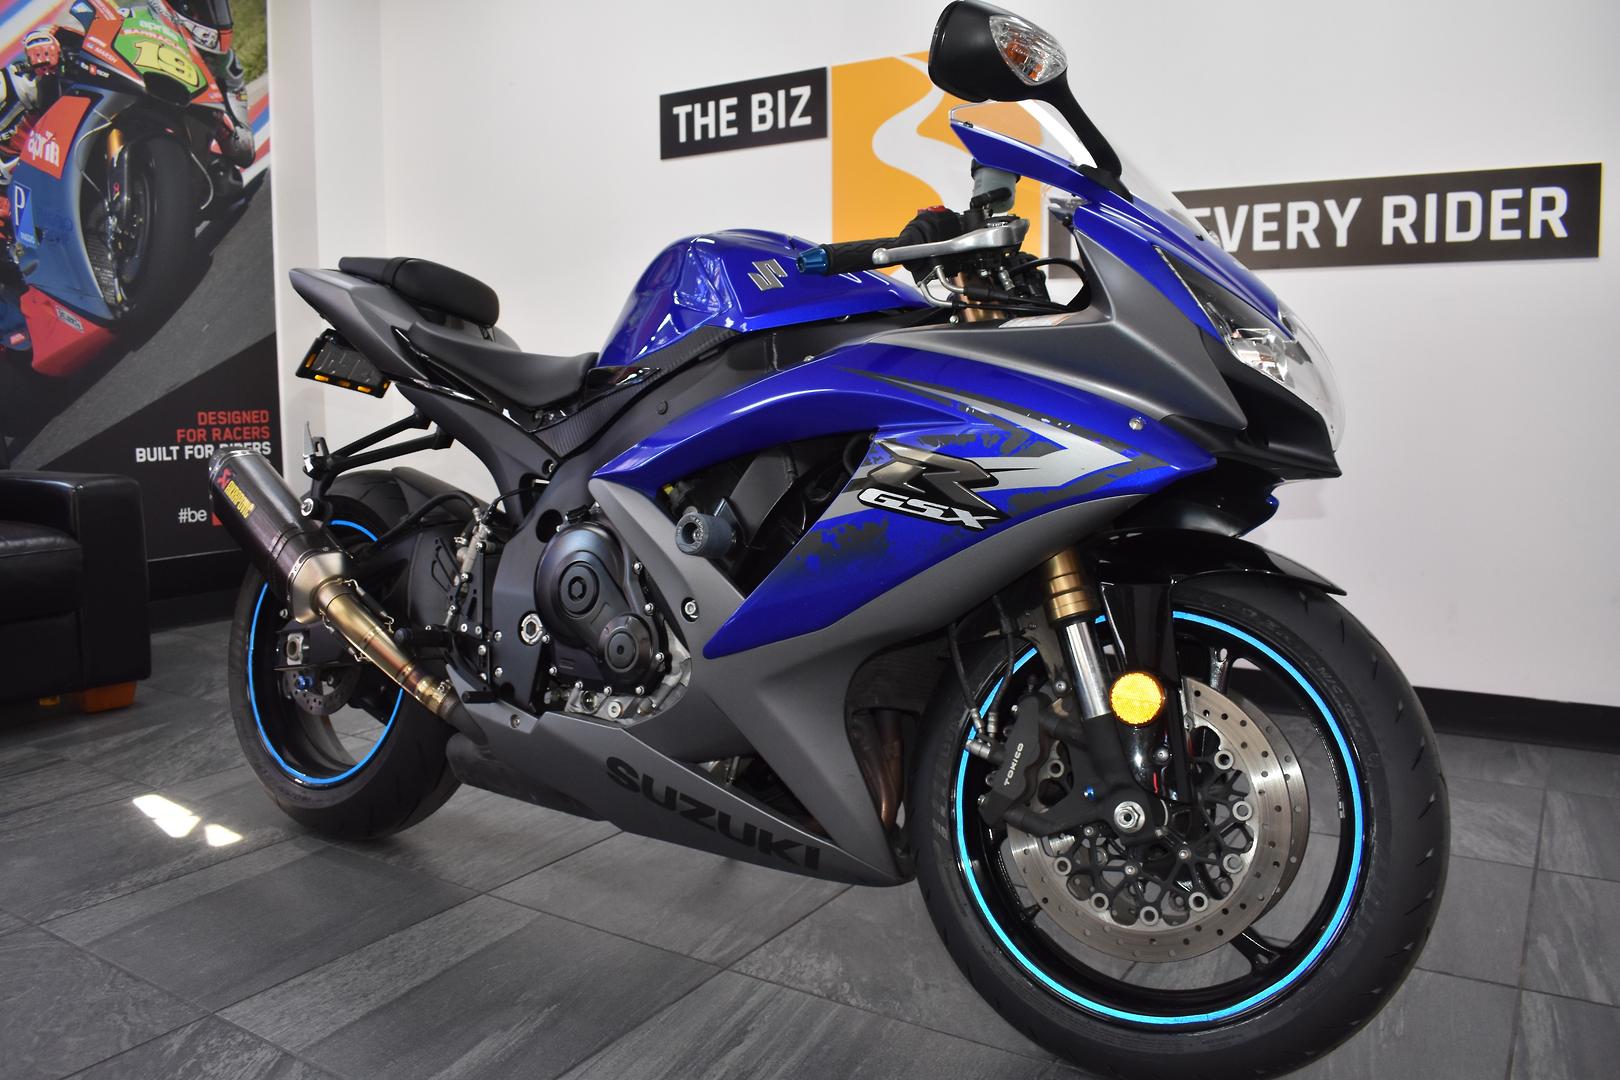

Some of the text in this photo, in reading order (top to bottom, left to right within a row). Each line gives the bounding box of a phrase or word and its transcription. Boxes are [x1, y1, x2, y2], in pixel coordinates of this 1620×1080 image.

[672, 85, 812, 143] THE BIZ
[1381, 186, 1568, 246] RIDER
[176, 426, 271, 443] FOR RACERS
[197, 410, 270, 425] DESIGNED
[135, 446, 180, 462] BUILT
[184, 444, 215, 460] FOR
[178, 507, 208, 523] #be
[858, 487, 1000, 530] GSX
[1003, 743, 1024, 786] TOKICO
[606, 756, 821, 870] SUZUKI
